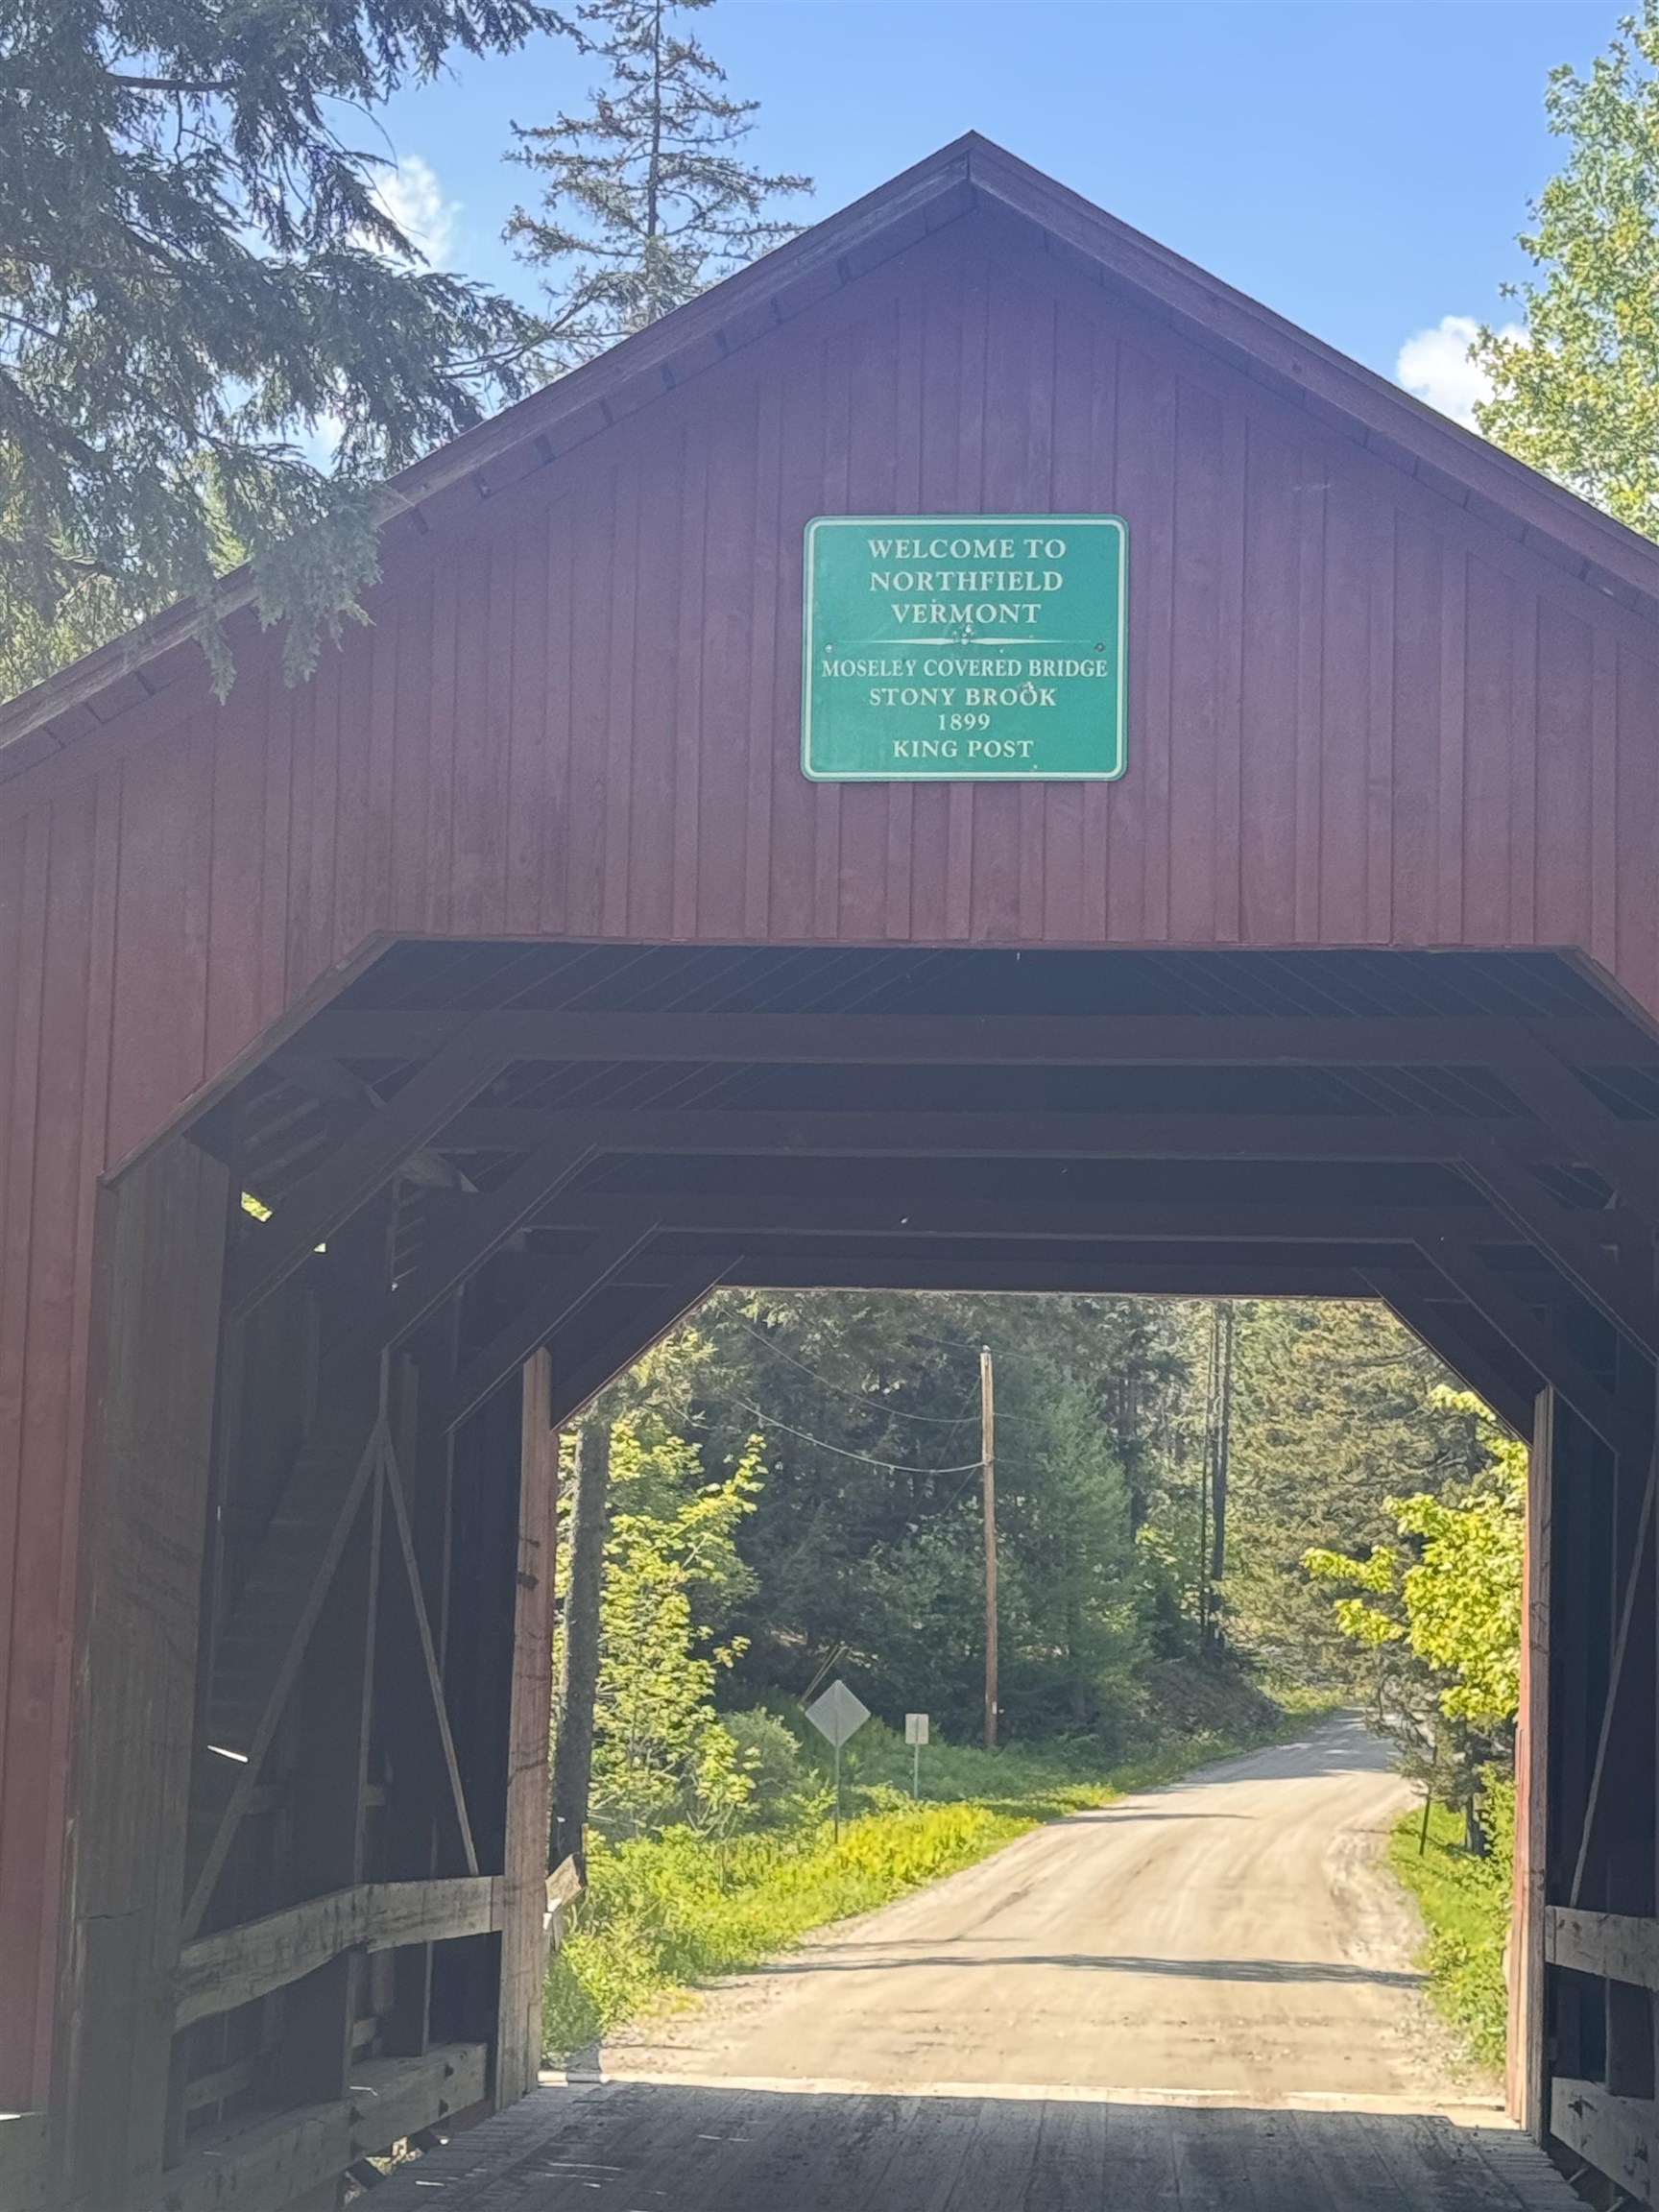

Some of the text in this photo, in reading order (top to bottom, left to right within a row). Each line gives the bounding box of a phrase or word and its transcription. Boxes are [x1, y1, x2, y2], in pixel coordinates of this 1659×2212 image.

[868, 539, 1067, 559] WELCOME TO
[869, 571, 1064, 591] NORTHFIELD
[891, 603, 1042, 624] VERMONT
[821, 659, 1108, 677] MOSELEY COVERED BRIDGE
[869, 687, 1057, 706] STONY BROOK
[938, 713, 991, 731] 1899
[893, 740, 1034, 757] KING POST
